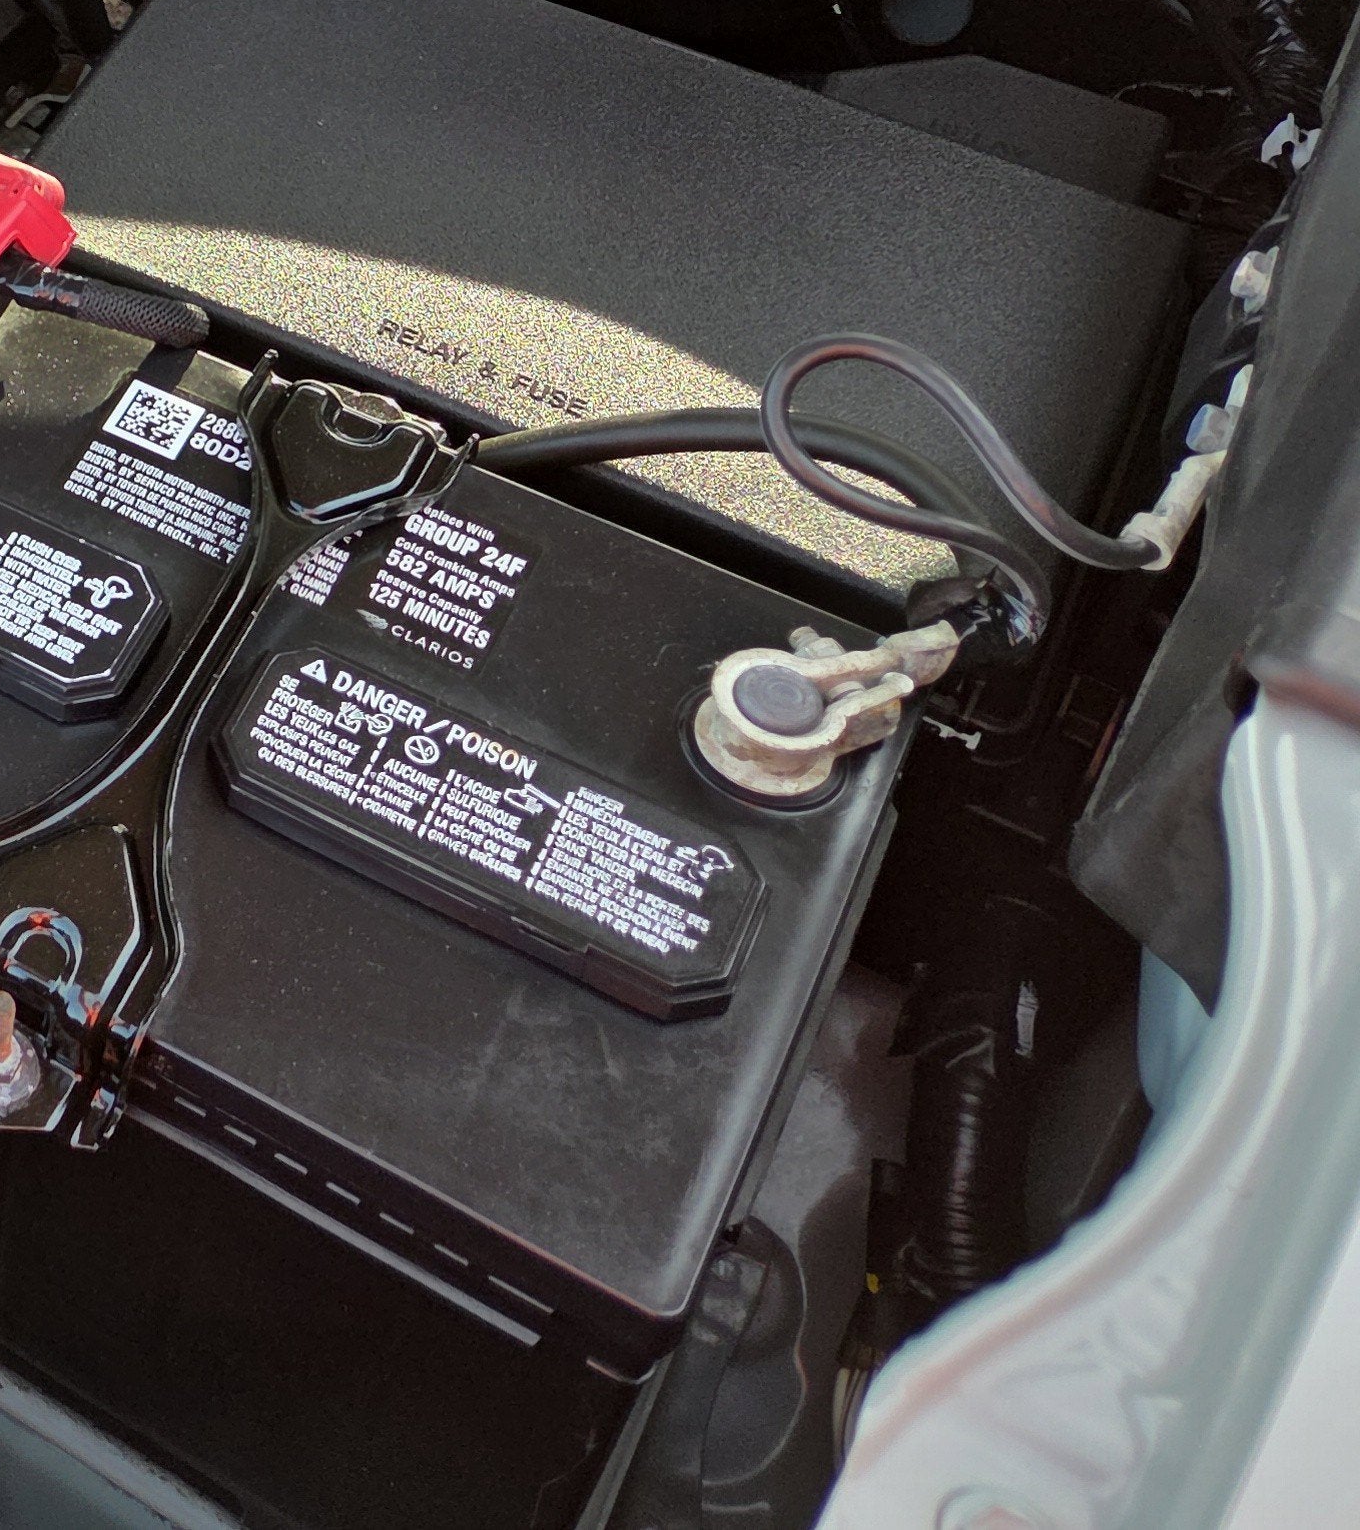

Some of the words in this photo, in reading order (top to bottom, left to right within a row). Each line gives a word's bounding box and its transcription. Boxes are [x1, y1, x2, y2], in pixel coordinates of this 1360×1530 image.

[377, 318, 473, 365] RELAY
[512, 372, 589, 419] FUSE
[83, 450, 115, 472] DISTR.
[118, 466, 134, 478] BY
[134, 473, 175, 497] SERVCO
[175, 492, 216, 516] PACIFIC
[216, 510, 236, 526] INC.
[90, 441, 116, 459] DISTR.
[118, 453, 132, 464] BY
[131, 458, 163, 479] TOYOTA
[163, 473, 195, 493] MOTOR
[194, 487, 225, 506] NORTH
[76, 460, 102, 478] DISTR.
[104, 472, 117, 484] BY
[116, 478, 147, 498] TOYOTA
[146, 492, 160, 503] DE
[158, 497, 192, 518] PUERTO
[190, 512, 212, 527] RICO
[212, 521, 236, 538] CORP.
[95, 481, 108, 492] BY
[106, 486, 135, 505] TOYOTA
[64, 480, 97, 502] DISTR.
[101, 497, 118, 510] BY
[117, 505, 157, 528] ATKINS
[199, 542, 220, 559] INC.
[424, 504, 463, 528] eplace
[466, 522, 494, 542] With
[16, 534, 53, 559] FLUSH
[324, 544, 349, 562] EXAS
[404, 511, 480, 556] GROUP
[479, 546, 527, 576] 24F
[3, 557, 33, 577] WITH
[10, 546, 83, 586] IMMEDIATELY
[386, 549, 428, 578] 582
[428, 570, 495, 608] AMPS
[395, 537, 424, 556] Cold
[424, 550, 478, 582] Cranking
[479, 575, 515, 597] Amps
[13, 590, 36, 605] OUT
[17, 579, 62, 608] MEDICAL
[62, 600, 93, 620] HELP
[90, 614, 122, 635] FAST
[290, 583, 326, 606] GUAM
[376, 570, 426, 598] Reserve
[428, 593, 482, 624] Capacity
[369, 583, 402, 608] 125
[402, 598, 490, 648] MINUTES
[391, 625, 474, 668] CLARIOS
[279, 675, 300, 692] SE
[257, 714, 308, 746] EXPLOSIFS
[308, 740, 353, 767] PEUVENT
[264, 700, 289, 720] LES
[290, 712, 321, 736] YEUX
[317, 729, 337, 744] LES
[338, 738, 360, 756] GAZ
[258, 747, 276, 762] OU
[274, 754, 296, 772] DES
[308, 756, 322, 770] LA
[383, 758, 440, 792] AUCUNE
[370, 784, 413, 812] FLAMME
[454, 774, 502, 804] L'ACIDE
[441, 803, 470, 822] PEUT
[446, 788, 521, 830] SULFURIQUE
[566, 811, 588, 828] LES
[591, 822, 620, 844] YEUX
[427, 829, 468, 855] GRAVES
[434, 816, 448, 830] LA
[484, 839, 501, 853] OU
[554, 836, 587, 858] SANS
[560, 824, 628, 862] CONSULTER
[629, 855, 648, 872] UN
[584, 889, 600, 903] LE
[628, 886, 642, 898] LA
